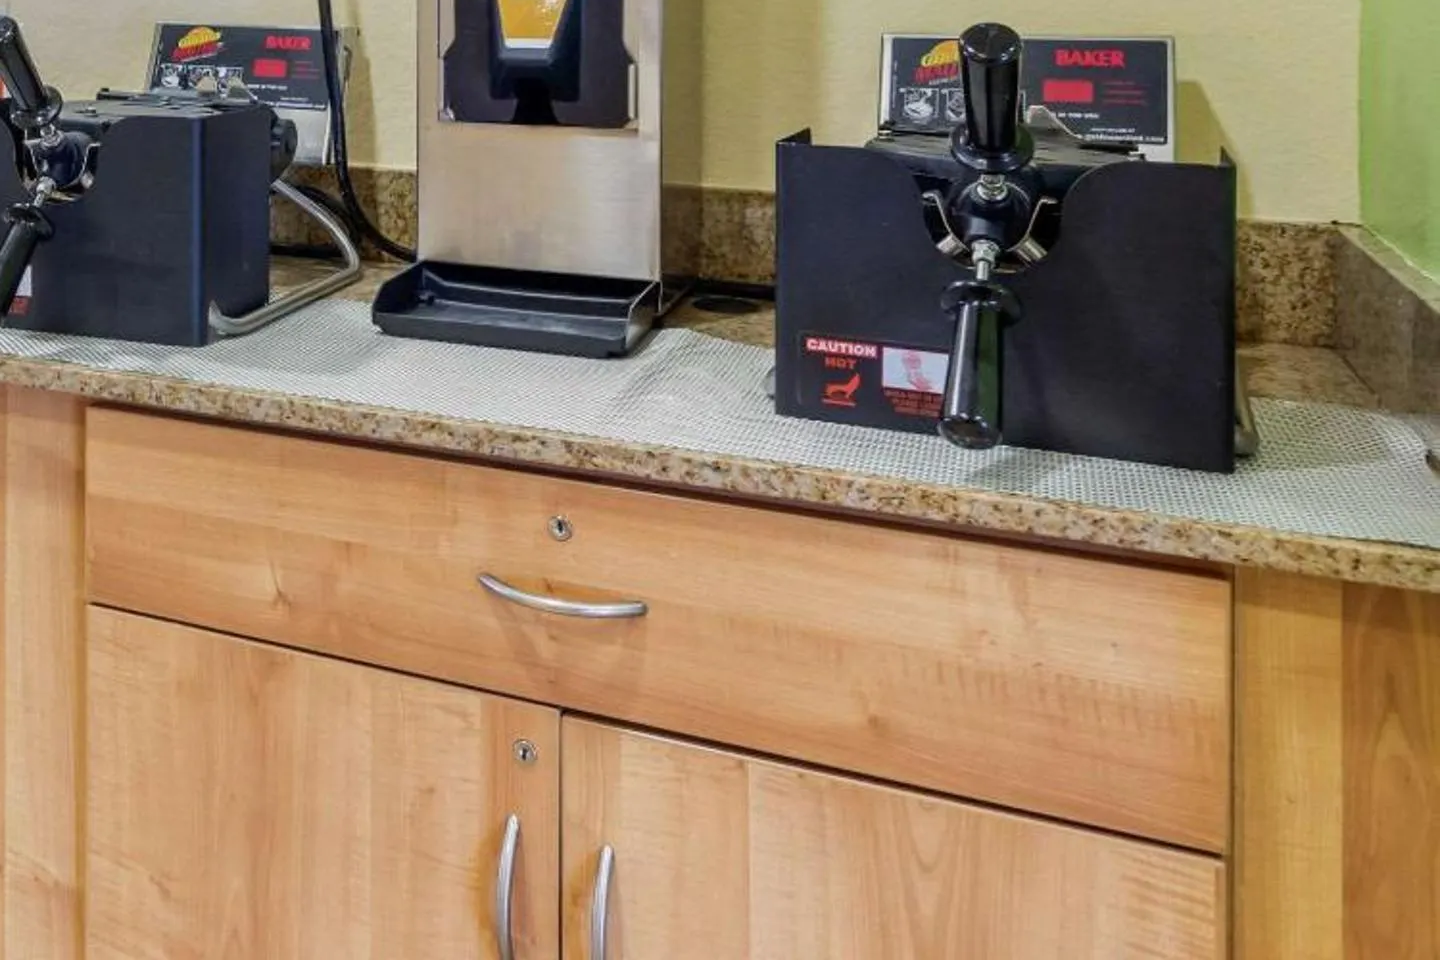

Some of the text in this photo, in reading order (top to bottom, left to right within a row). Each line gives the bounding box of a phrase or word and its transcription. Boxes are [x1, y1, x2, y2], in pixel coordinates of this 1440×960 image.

[1055, 49, 1125, 68] BAKER
[806, 339, 877, 358] CAUTION
[825, 357, 857, 369] HOT
